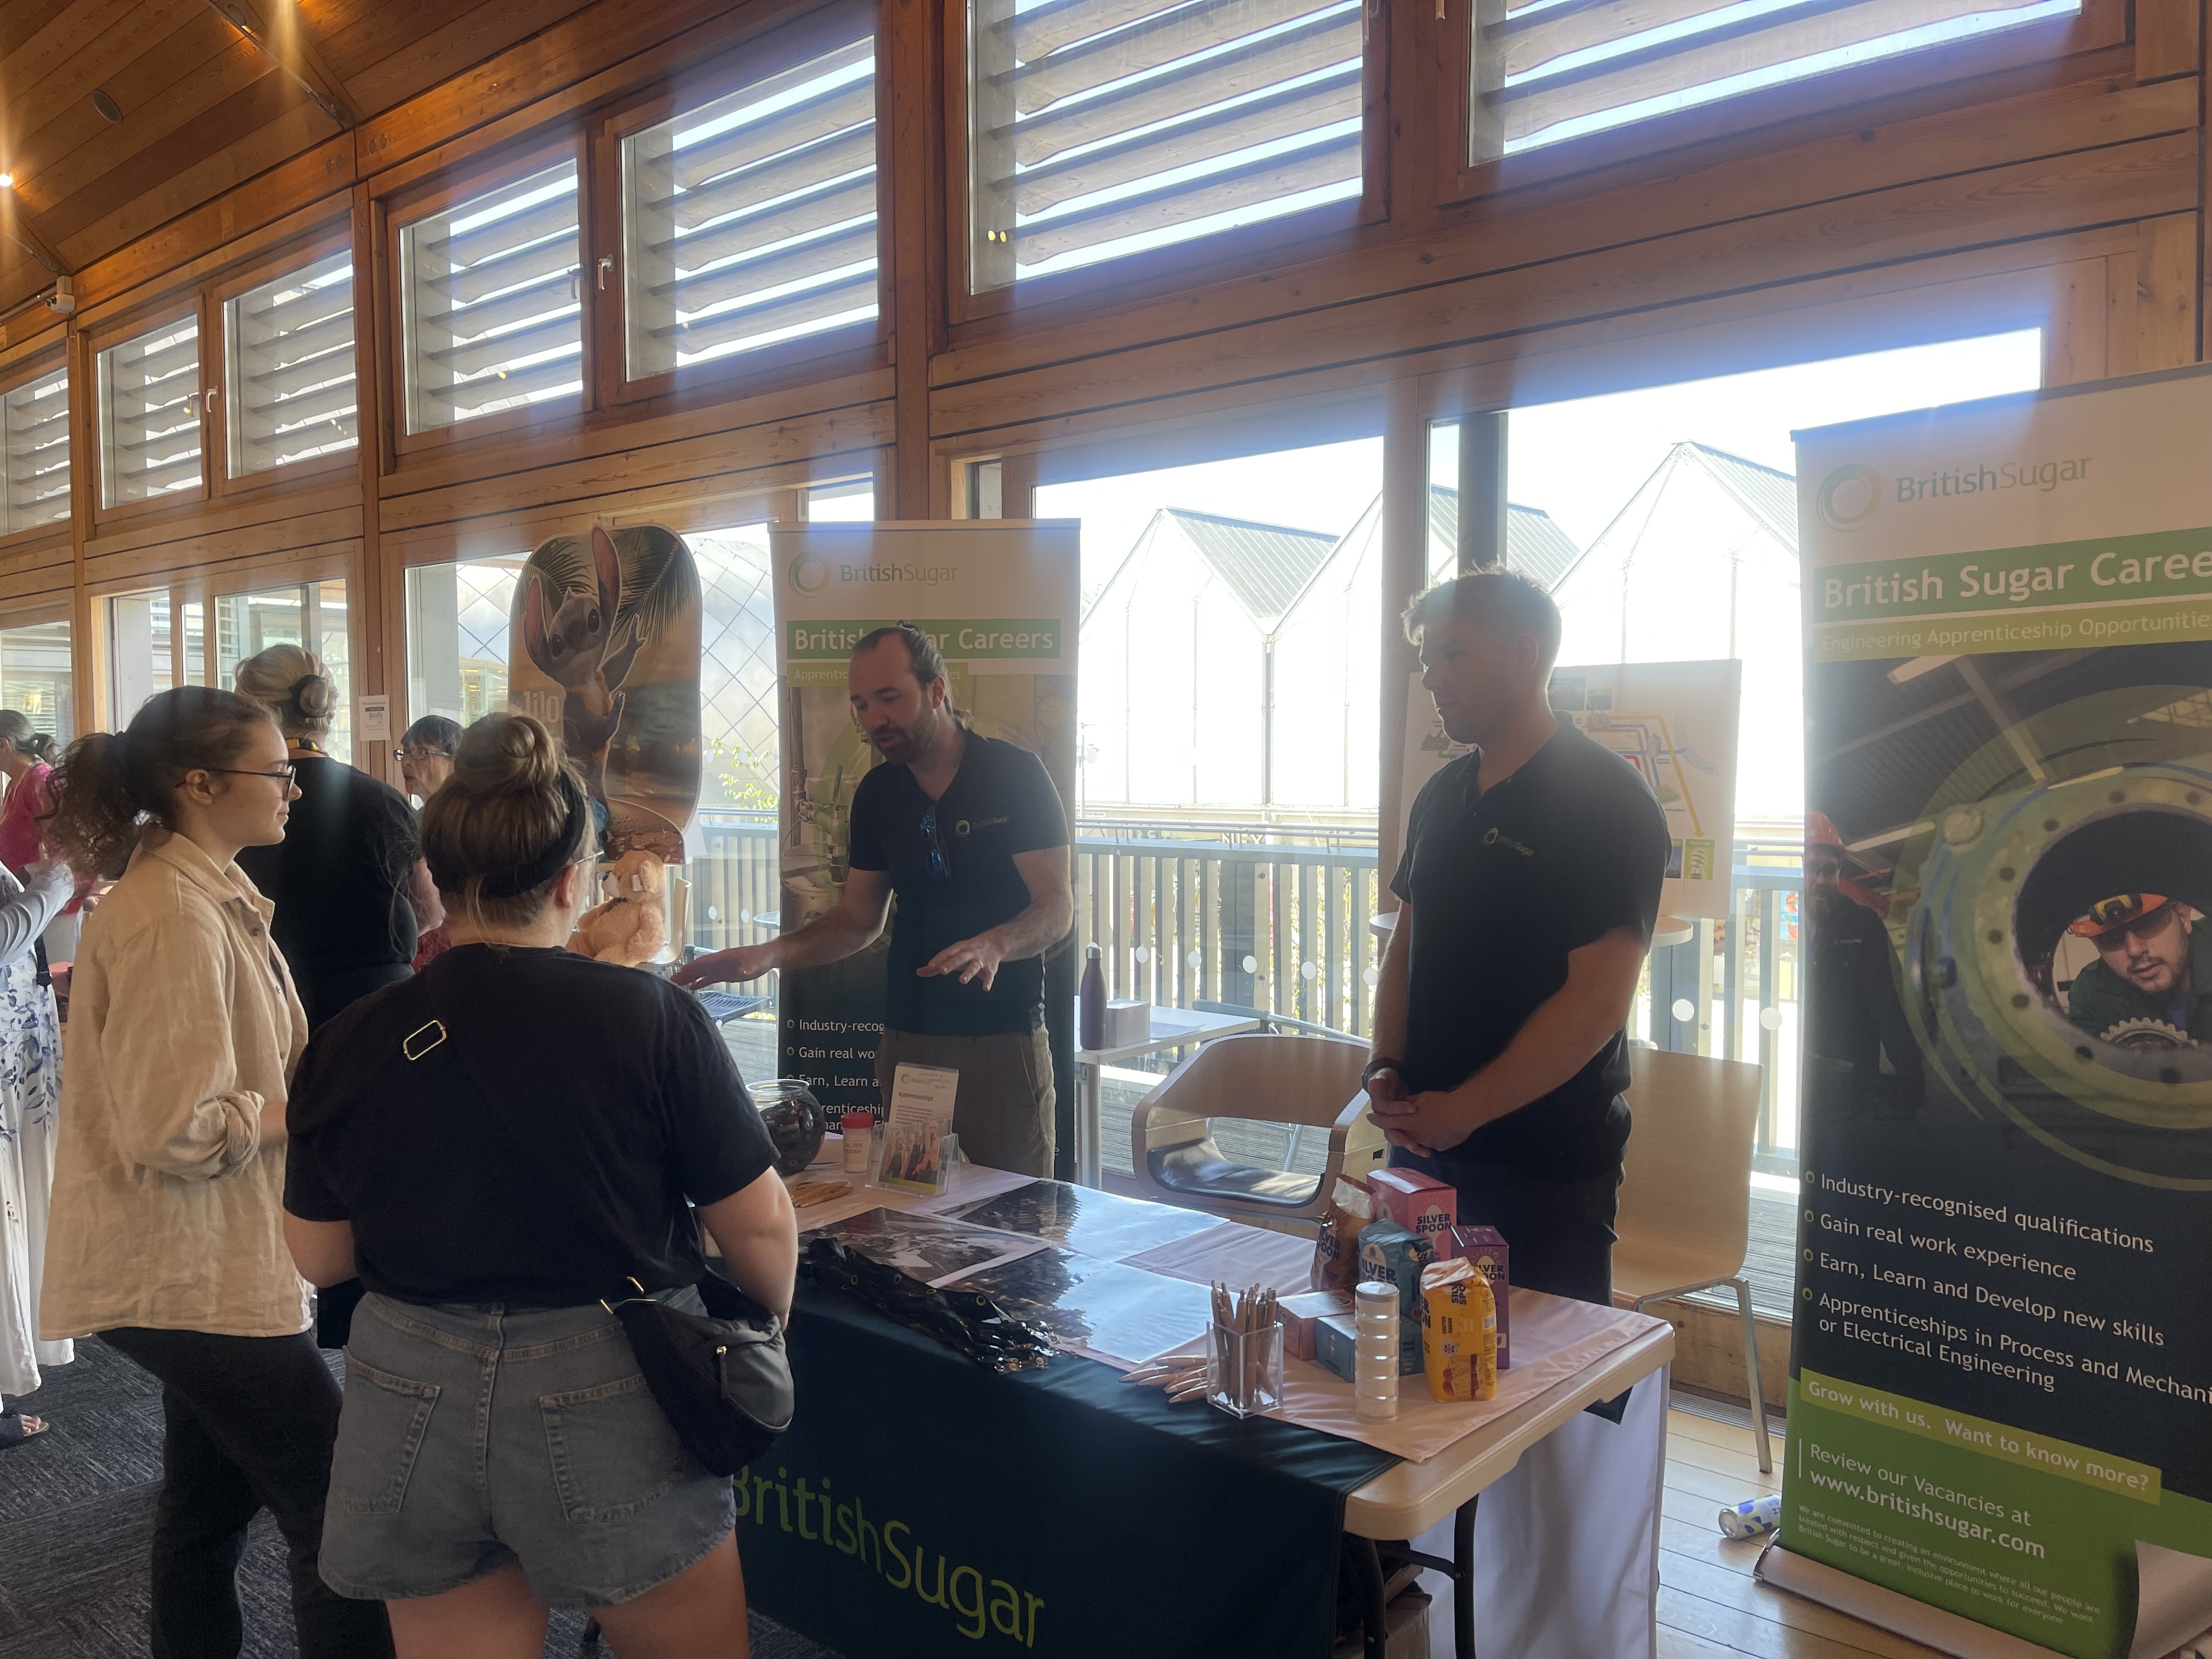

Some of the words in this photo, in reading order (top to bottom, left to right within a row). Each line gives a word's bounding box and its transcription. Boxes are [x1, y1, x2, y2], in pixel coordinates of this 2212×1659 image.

[1896, 457, 2092, 504] BritishSugar
[839, 563, 958, 586] BritishSugar
[1824, 568, 1944, 609] British
[1959, 563, 2075, 602] Sugar
[2090, 550, 2212, 586] Caree
[958, 628, 1054, 650] Careers
[1822, 631, 1921, 654] Engineering
[1927, 613, 2072, 648] Apprenticeship
[2079, 611, 2212, 639] Opportunitie
[799, 1047, 826, 1059] Gain
[830, 1047, 854, 1059] real
[858, 1050, 878, 1059] wo
[834, 1075, 868, 1087] Learn
[1415, 1222, 1452, 1233] SPOON
[1417, 1214, 1451, 1224] SILVER
[1820, 1214, 1859, 1236] Gain
[1867, 1226, 1904, 1244] real
[1910, 1234, 1958, 1256] work
[1964, 1245, 2076, 1280] experience
[1821, 1173, 2007, 1223] Industry-recognised
[2015, 1212, 2154, 1252] qualifications
[1820, 1252, 1865, 1280] Earn,
[1874, 1264, 1926, 1290] Learn
[1933, 1280, 1968, 1300] and
[1976, 1286, 2056, 1323] Develop
[2063, 1310, 2106, 1331] new
[2113, 1319, 2165, 1346] skills
[1819, 1293, 1968, 1341] Apprenticeships
[1975, 1329, 1992, 1347] in
[2000, 1334, 2075, 1367] Process
[2081, 1358, 2119, 1379] and
[1819, 1319, 1837, 1333] or
[1843, 1322, 1932, 1358] Electrical
[1939, 1344, 2055, 1393] Engineering
[1809, 1381, 1854, 1406] Grow
[1859, 1398, 1899, 1419] with
[1906, 1412, 1932, 1429] us.
[1945, 1418, 1993, 1447] Want
[1999, 1435, 2019, 1453] to
[2026, 1442, 2080, 1470] know
[2086, 1462, 2149, 1491] more?
[1810, 1443, 1872, 1476] Review
[1877, 1466, 1908, 1487] our
[1914, 1475, 2006, 1518] Vacancies
[2012, 1507, 2032, 1527] at
[1810, 1471, 2045, 1559] www.britishsugar.com
[1798, 1504, 1810, 1514] We
[1812, 1509, 1825, 1519] are
[1827, 1516, 1871, 1536] committed
[1873, 1530, 1882, 1539] to
[1884, 1535, 1918, 1553] creating
[1921, 1547, 1930, 1556] an
[1933, 1551, 1986, 1576] environment
[1989, 1571, 2016, 1585] where
[2019, 1580, 2030, 1590] all
[2033, 1585, 2047, 1595] our
[1798, 1524, 1823, 1539] British
[1826, 1534, 1847, 1548] Sugar
[1849, 1543, 1858, 1552] to
[1860, 1547, 1870, 1556] be
[1880, 1555, 1904, 1570] great,
[1907, 1564, 1943, 1582] inclusive
[1945, 1577, 1968, 1592] place
[1971, 1587, 1980, 1595] to
[1983, 1592, 2003, 1604] work
[2007, 1598, 2019, 1609] for
[1799, 1514, 1827, 1531] treated
[1829, 1526, 1847, 1537] with
[1849, 1534, 1878, 1549] respect
[1882, 1544, 1897, 1555] and
[1899, 1551, 1920, 1563] given
[1923, 1559, 1937, 1570] the
[1939, 1565, 1997, 1590] opportunities
[1999, 1585, 2008, 1594] to
[2054, 1602, 2068, 1614] We
[2070, 1610, 2094, 1623] want
